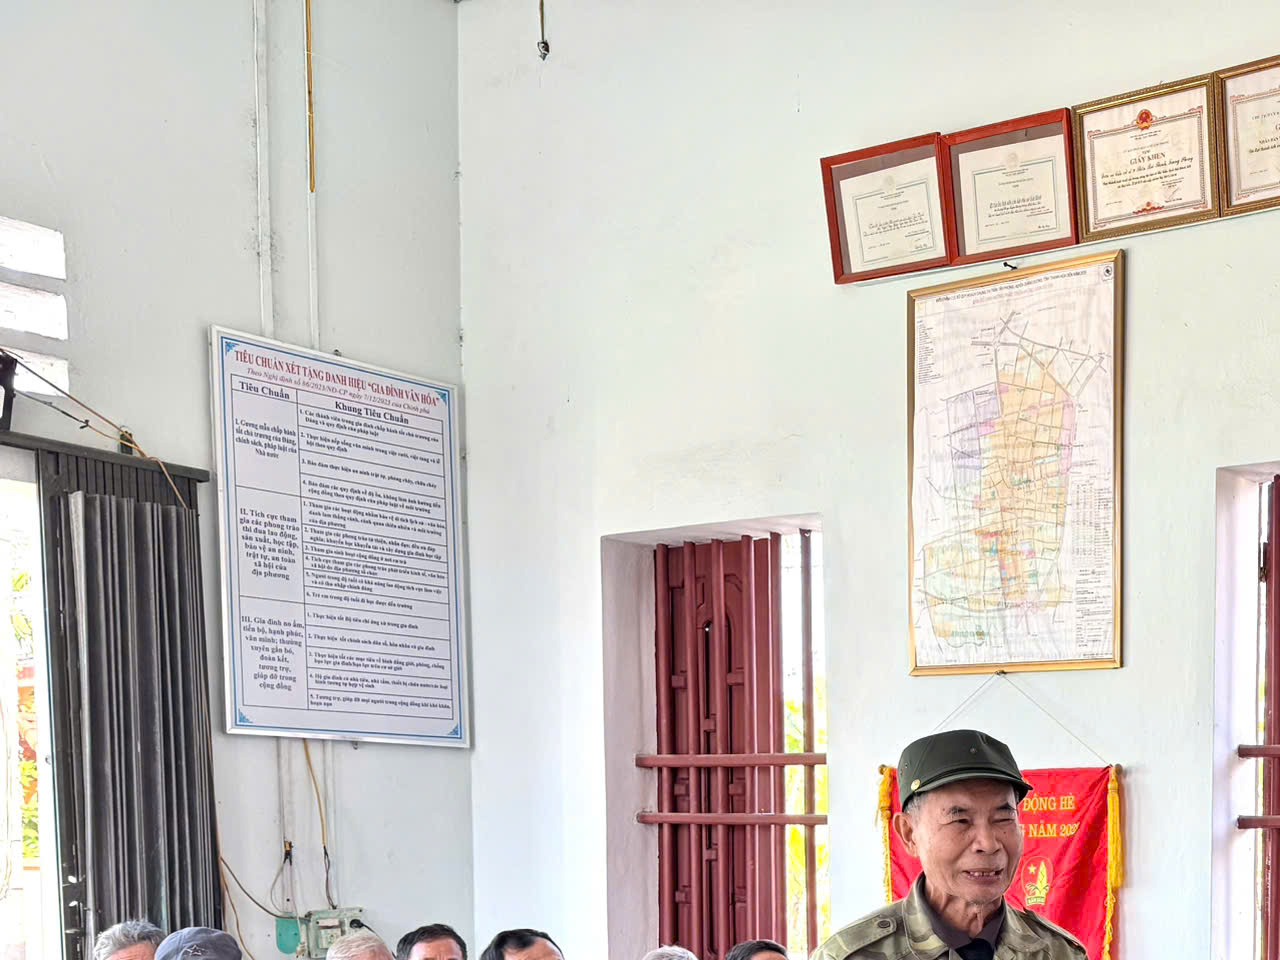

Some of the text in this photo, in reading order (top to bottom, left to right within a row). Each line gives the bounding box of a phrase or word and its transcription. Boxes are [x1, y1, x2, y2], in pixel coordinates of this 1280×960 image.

[234, 349, 254, 365] TIÊU
[284, 360, 302, 376] XÉT
[301, 365, 325, 382] TẶNG
[324, 371, 347, 387] DANH
[347, 376, 367, 392] HIỆU
[238, 380, 290, 401] Tiêu Chuẩn
[334, 400, 409, 425] Khung Tiêu Chuẩn
[1022, 792, 1076, 814] ĐỘNG HÈ
[1028, 819, 1057, 838] NĂM
